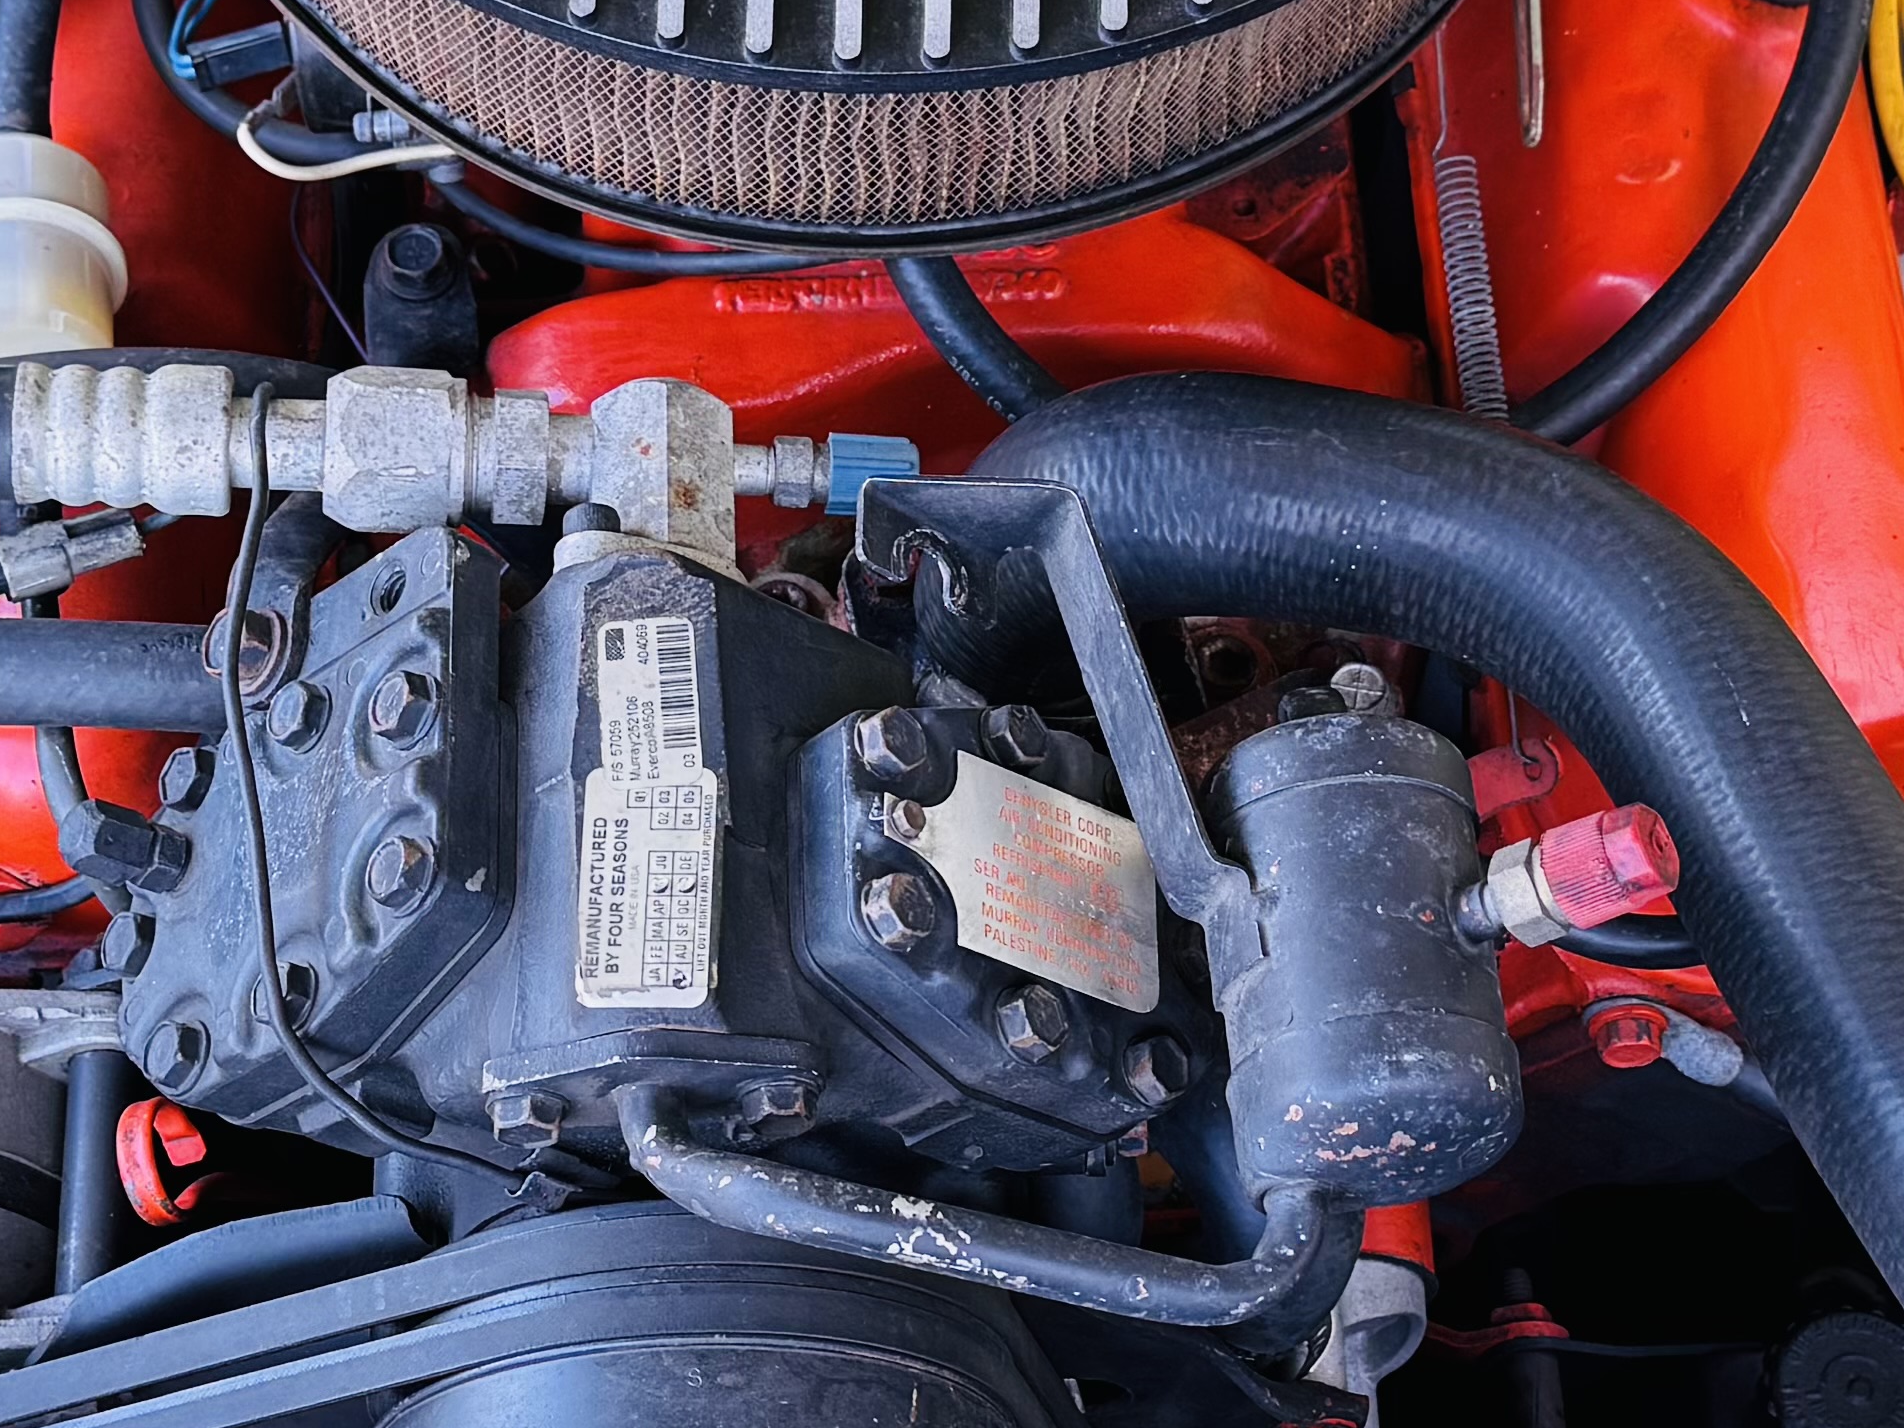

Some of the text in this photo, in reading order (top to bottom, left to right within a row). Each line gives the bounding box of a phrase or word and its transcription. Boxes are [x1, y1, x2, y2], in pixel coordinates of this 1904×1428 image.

[608, 719, 623, 781] F/S 57059
[683, 753, 695, 767] 03
[1012, 832, 1106, 879] COMPRESSOR
[1025, 816, 1124, 867] CONDITIONING
[629, 864, 640, 885] USA
[679, 854, 692, 870] DE
[584, 816, 607, 978] REMANUFACTURED
[606, 817, 629, 973] BY FOUR SEASONS
[649, 789, 670, 981] JA FE MA AP JU 02 03
[696, 794, 713, 971] LIFT OUT MONTH AND YEAR PURCHASED
[627, 901, 638, 930] MADE
[676, 899, 689, 914] OC
[676, 921, 688, 936] SE
[674, 943, 687, 959] AU
